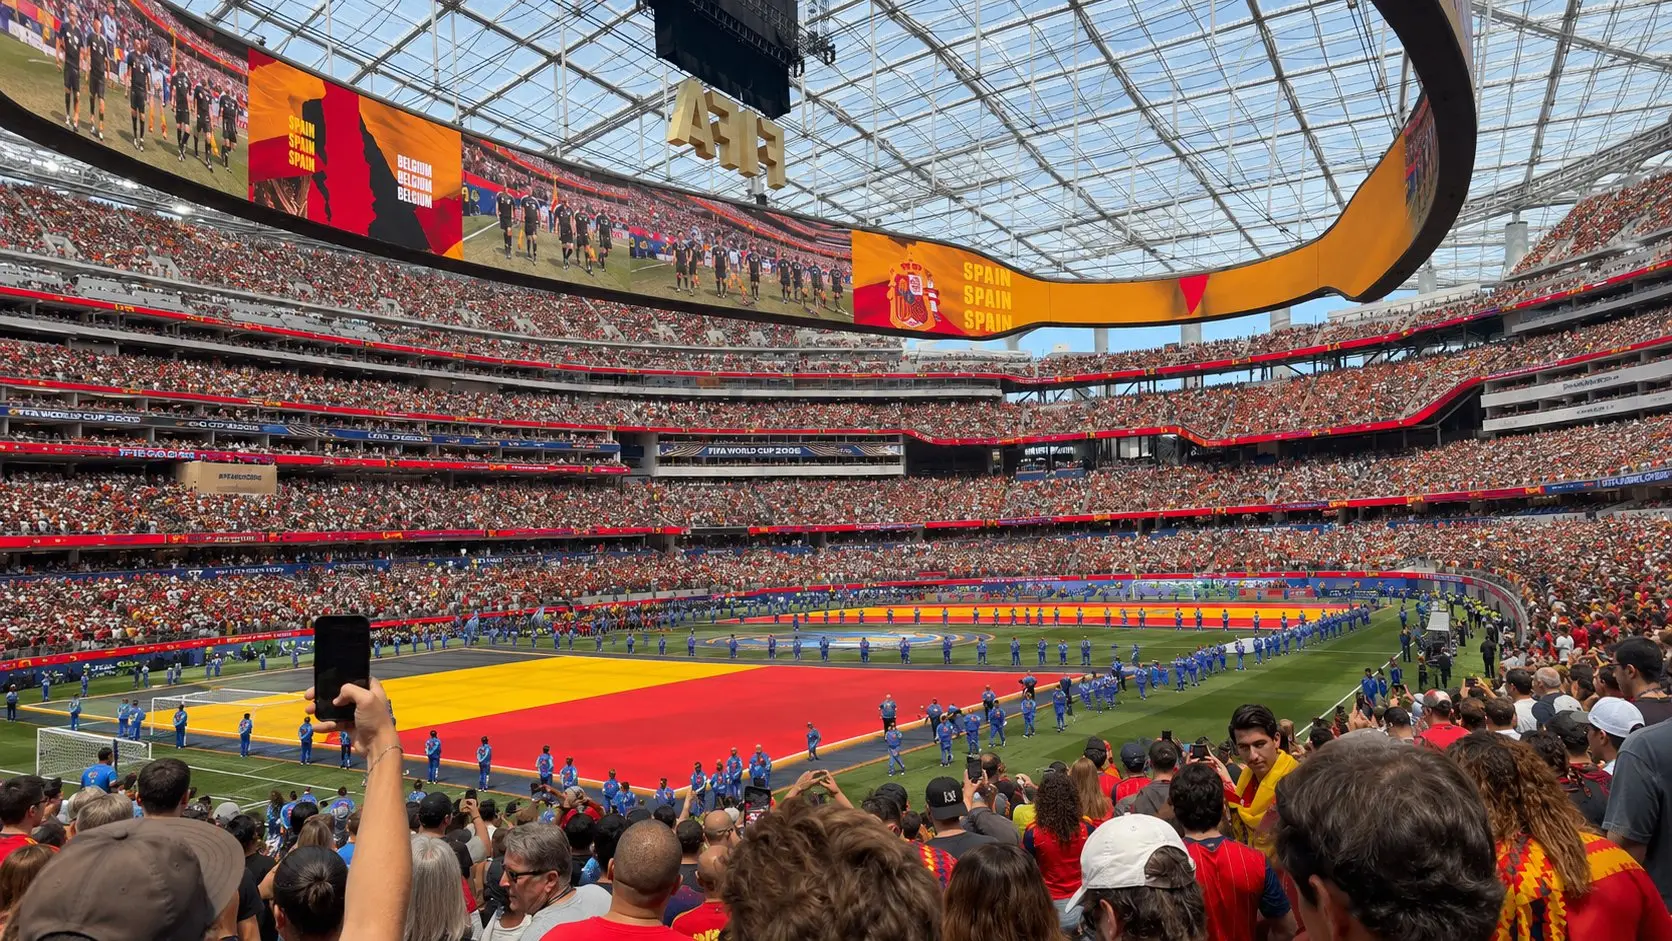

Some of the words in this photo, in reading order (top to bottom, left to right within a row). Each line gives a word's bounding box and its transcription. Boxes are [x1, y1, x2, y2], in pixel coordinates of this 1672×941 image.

[288, 114, 316, 139] SPAIN
[288, 132, 316, 156] SPAIN
[288, 149, 316, 173] SPAIN
[397, 153, 433, 178] BELGIUM
[397, 169, 433, 194] BELGIUM
[397, 185, 433, 209] BELGIUM
[963, 261, 1011, 288] SPAIN
[963, 284, 1012, 310] SPAIN
[963, 309, 1013, 333] SPAIN
[82, 411, 105, 421] CUP
[708, 447, 727, 455] FIFA
[727, 447, 757, 455] WORLD
[757, 447, 774, 455] CUP
